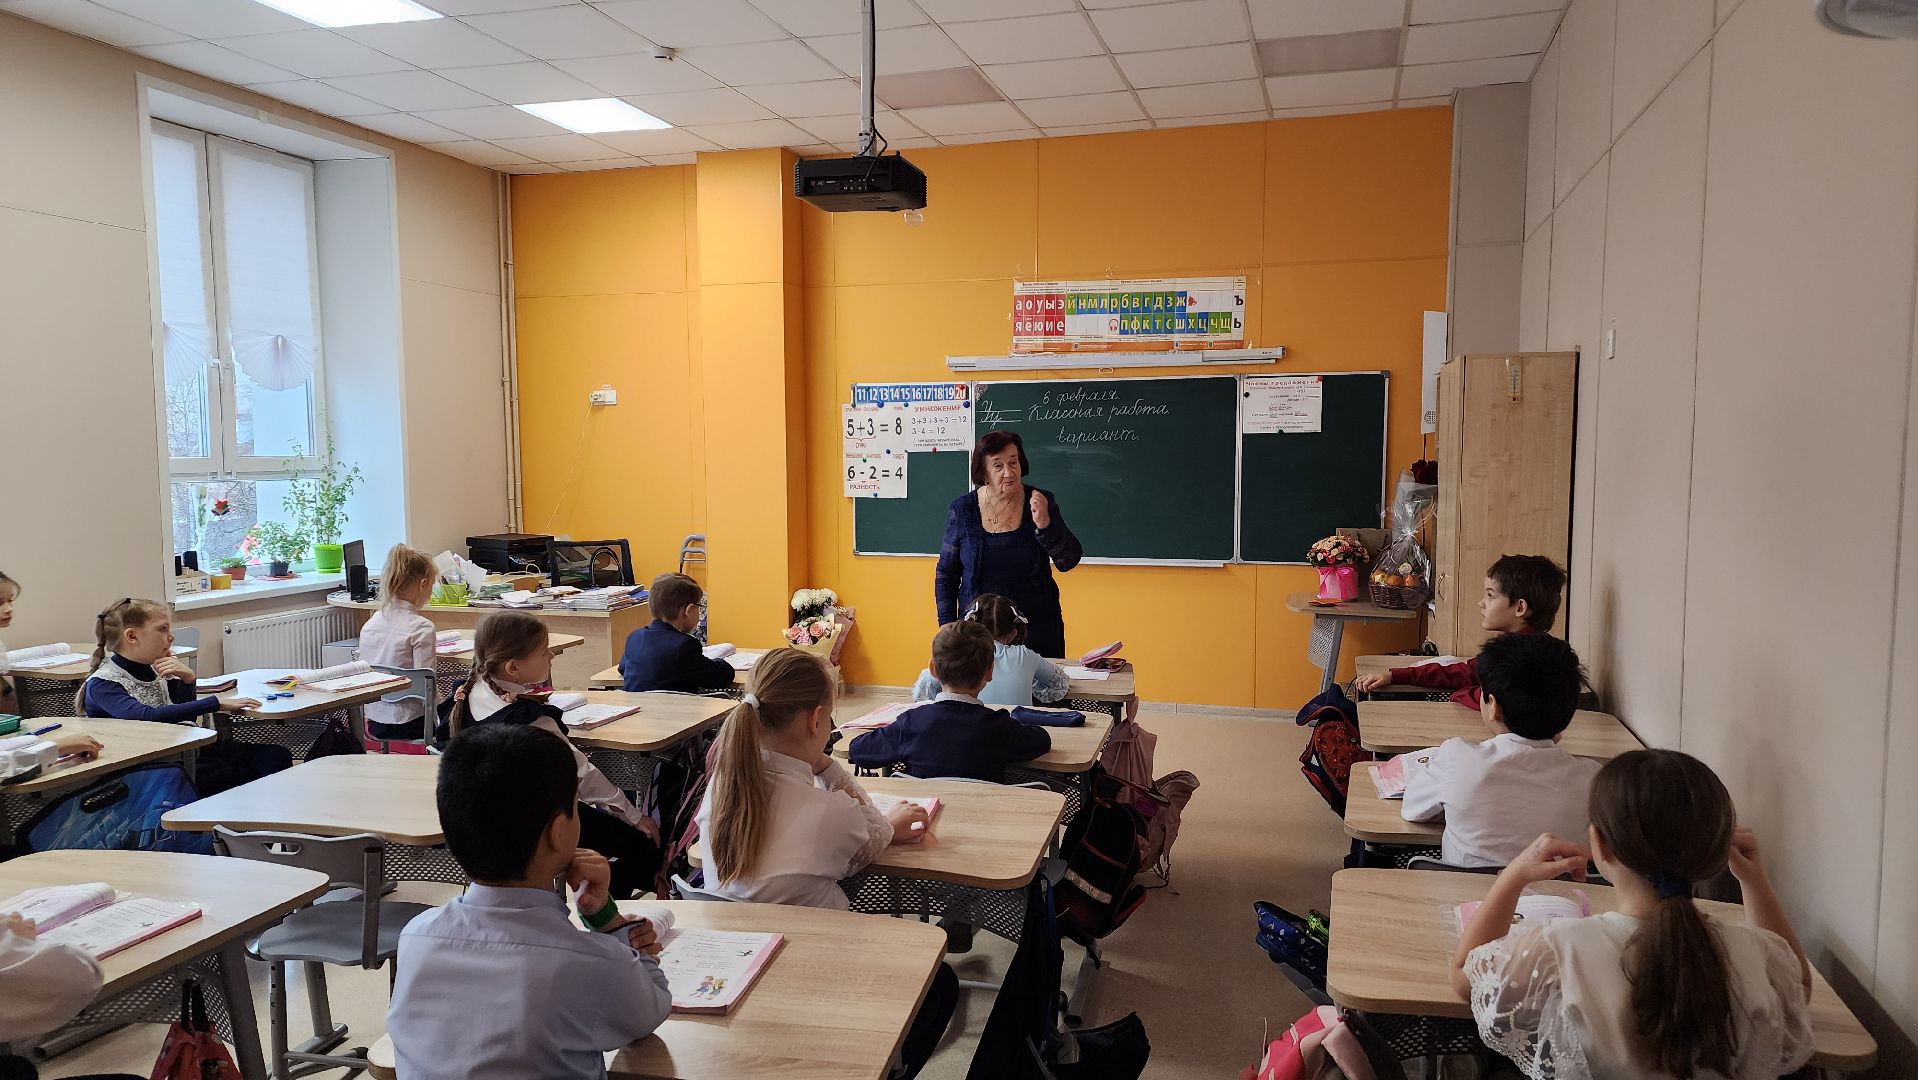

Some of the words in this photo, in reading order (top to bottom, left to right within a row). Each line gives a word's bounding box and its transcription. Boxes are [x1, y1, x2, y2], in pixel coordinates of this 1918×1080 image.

[1016, 300, 1022, 311] а
[1026, 300, 1033, 310] о
[1036, 299, 1043, 314] у
[1045, 300, 1054, 309] ы
[1058, 299, 1064, 309] э
[1015, 322, 1022, 332] я
[857, 389, 866, 400] 11
[869, 389, 877, 400] 12
[880, 389, 888, 400] 13
[890, 388, 899, 400] 14
[901, 388, 910, 400] 15
[912, 388, 921, 400] 16
[923, 388, 932, 400] 17
[934, 388, 943, 399] 18
[945, 387, 954, 399] 19
[895, 417, 902, 435] 8
[848, 466, 855, 479] 6
[869, 466, 877, 479] 2
[895, 467, 903, 480] 4
